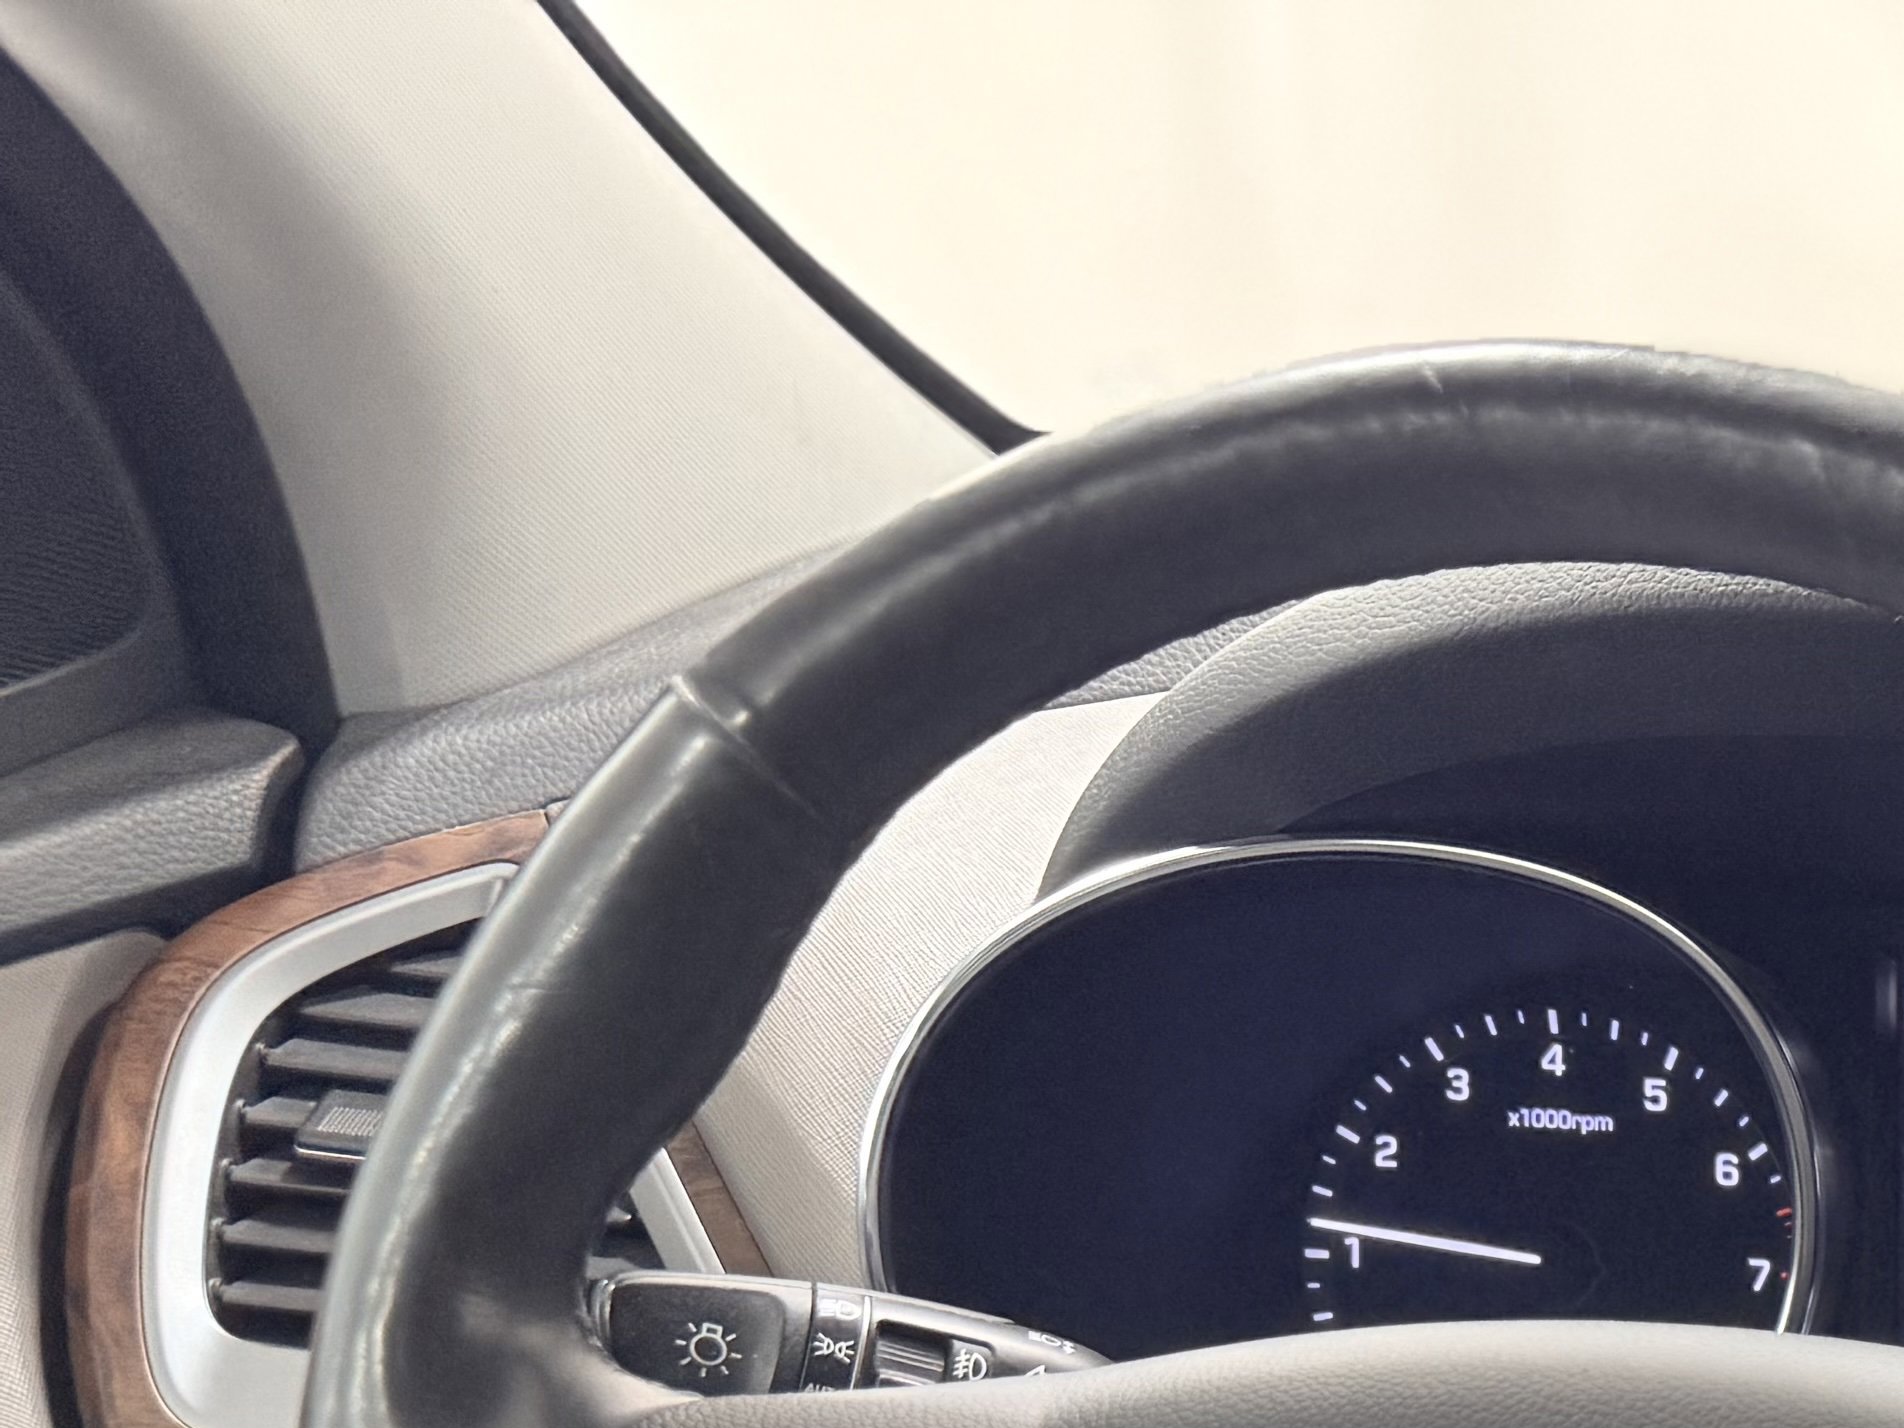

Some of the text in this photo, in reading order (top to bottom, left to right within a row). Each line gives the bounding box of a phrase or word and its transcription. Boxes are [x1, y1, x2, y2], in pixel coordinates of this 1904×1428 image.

[1541, 1045, 1565, 1077] 4
[1446, 1069, 1470, 1101] 3
[1642, 1078, 1667, 1113] 5
[1508, 1106, 1613, 1134] x1000rpm
[1374, 1135, 1398, 1167] 2
[1715, 1153, 1740, 1187] 6
[1344, 1237, 1361, 1268] 1
[1748, 1258, 1770, 1291] 7
